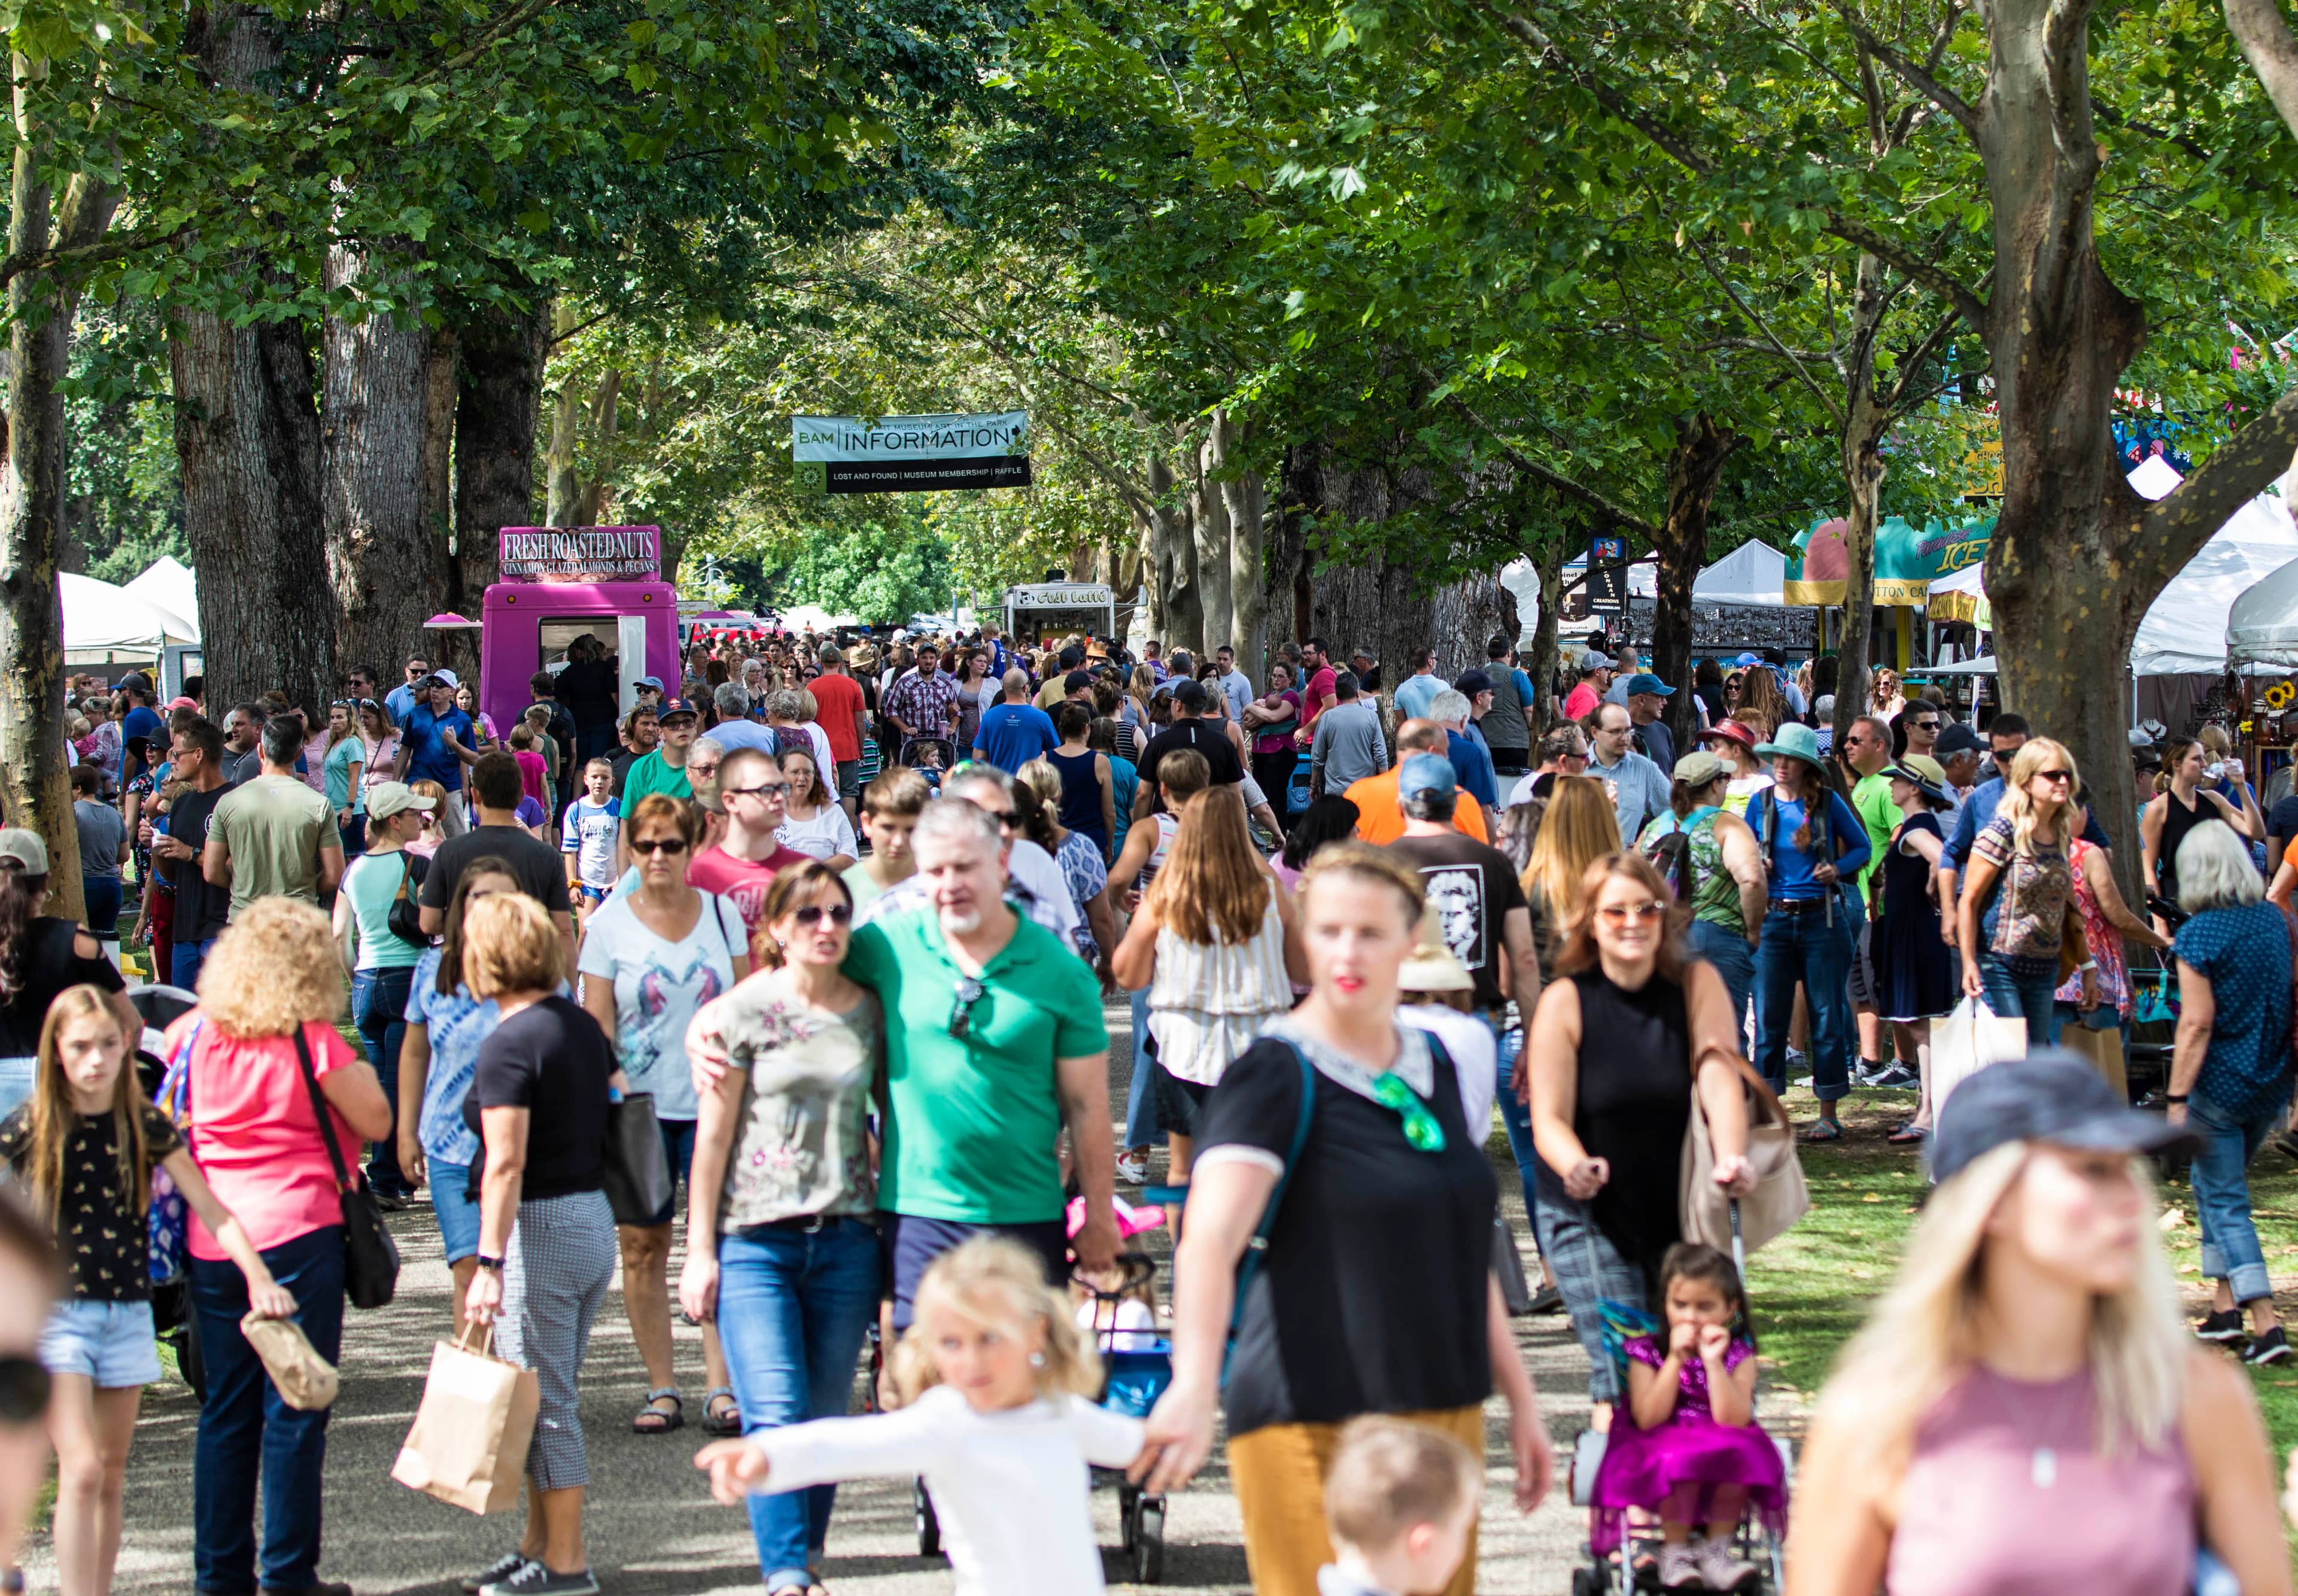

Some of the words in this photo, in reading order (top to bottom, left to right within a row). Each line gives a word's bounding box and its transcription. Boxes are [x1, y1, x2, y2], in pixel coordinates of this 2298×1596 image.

[800, 433, 834, 444] BAM
[846, 428, 1010, 451] INFORMATION
[939, 469, 989, 478] MEMBERSHIP
[504, 533, 548, 560] FRESH
[551, 533, 615, 560] ROASTED
[616, 531, 653, 559] NUTS
[1916, 527, 1972, 560] Paradise
[1935, 538, 1992, 574] ICE
[504, 562, 545, 574] CINNAMON
[547, 561, 577, 574] GLAZED
[579, 561, 615, 573] ALMONDS
[617, 561, 623, 573] &
[625, 560, 654, 573] PECANS
[1876, 586, 1904, 597] TTON
